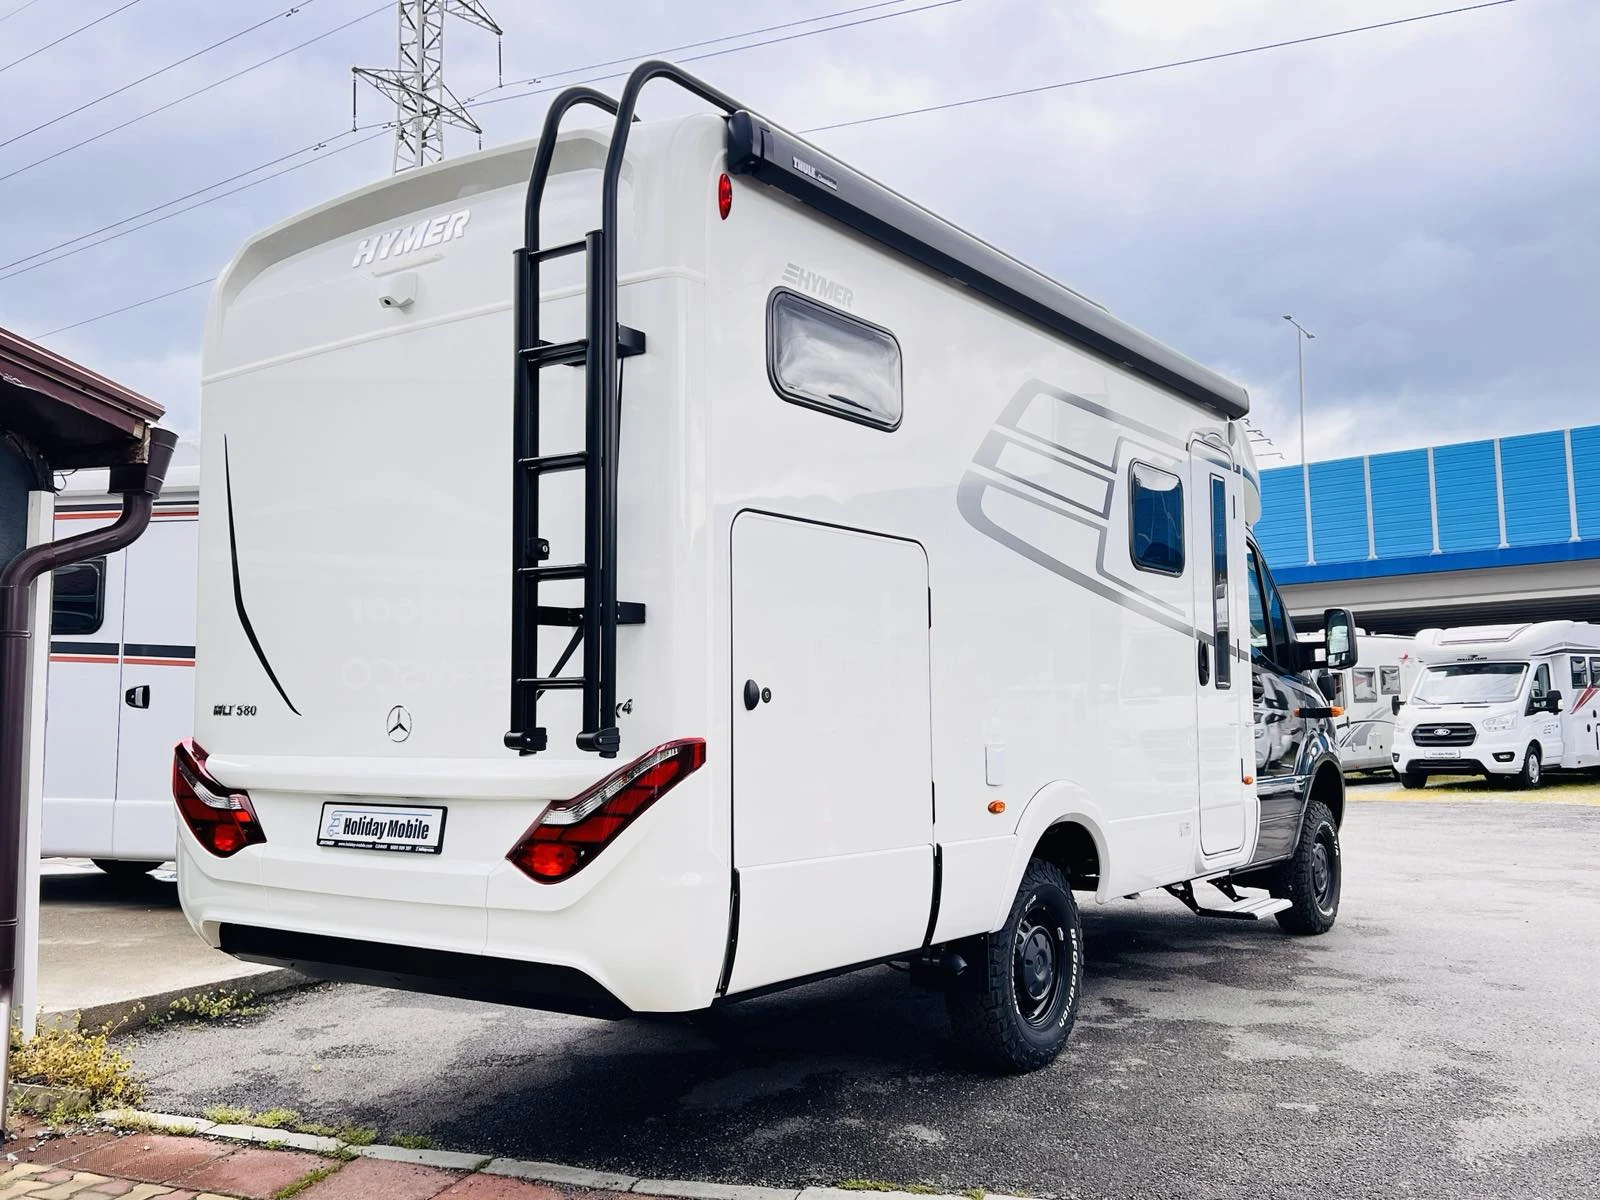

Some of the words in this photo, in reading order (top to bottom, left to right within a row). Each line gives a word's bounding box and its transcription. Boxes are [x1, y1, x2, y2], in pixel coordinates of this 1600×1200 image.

[352, 209, 471, 268] HYMER
[797, 267, 854, 308] HYMER
[236, 704, 257, 716] 580
[343, 816, 387, 840] Holiday
[387, 818, 430, 840] Mobile
[1058, 928, 1079, 1028] BFGoodrich
